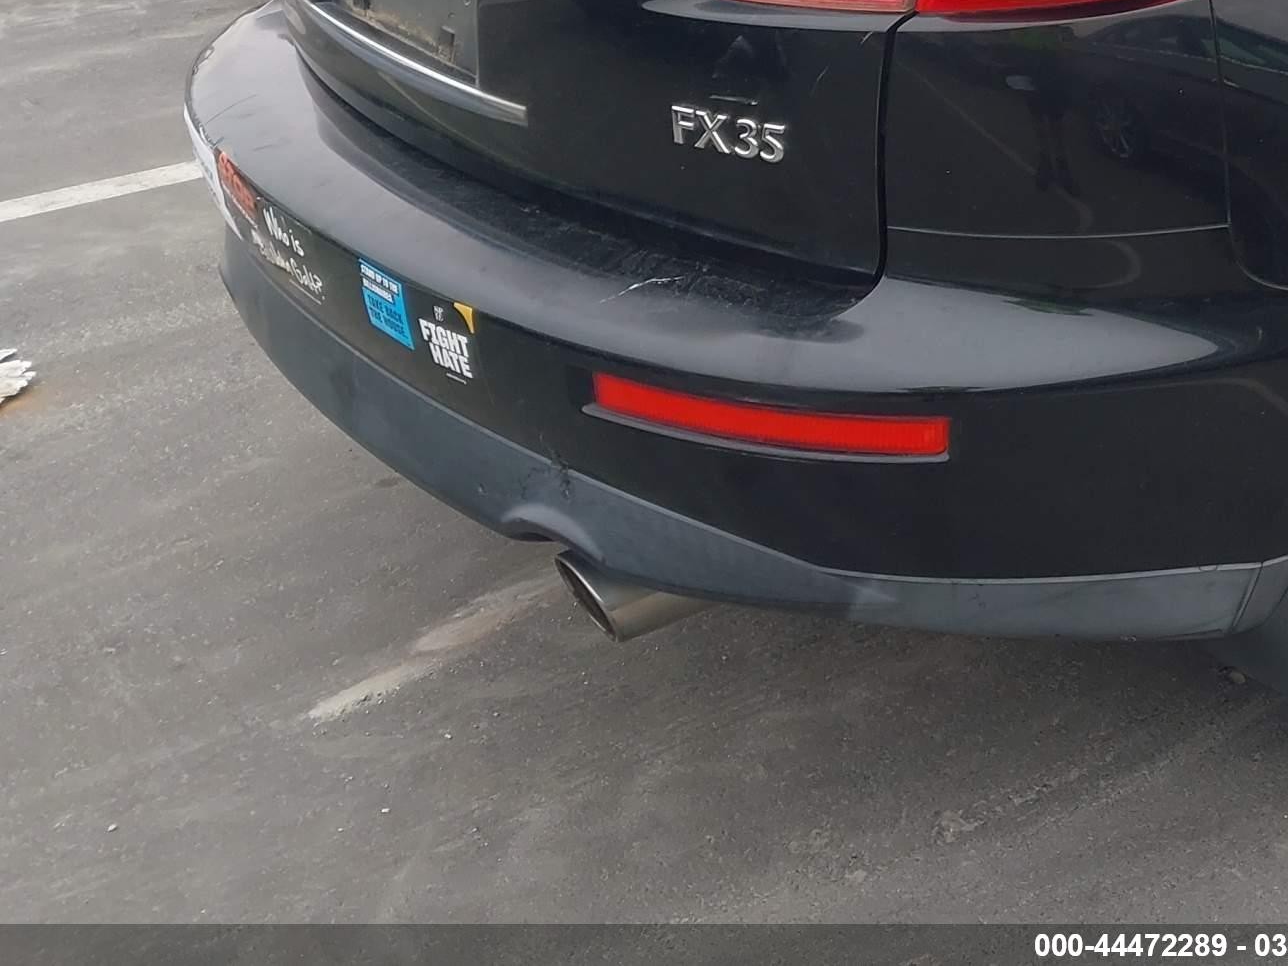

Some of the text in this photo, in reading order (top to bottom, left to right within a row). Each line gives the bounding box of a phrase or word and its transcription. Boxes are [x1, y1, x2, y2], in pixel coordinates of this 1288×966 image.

[671, 105, 785, 163] FX35
[418, 318, 469, 358] FIGHT
[429, 342, 473, 379] HATE
